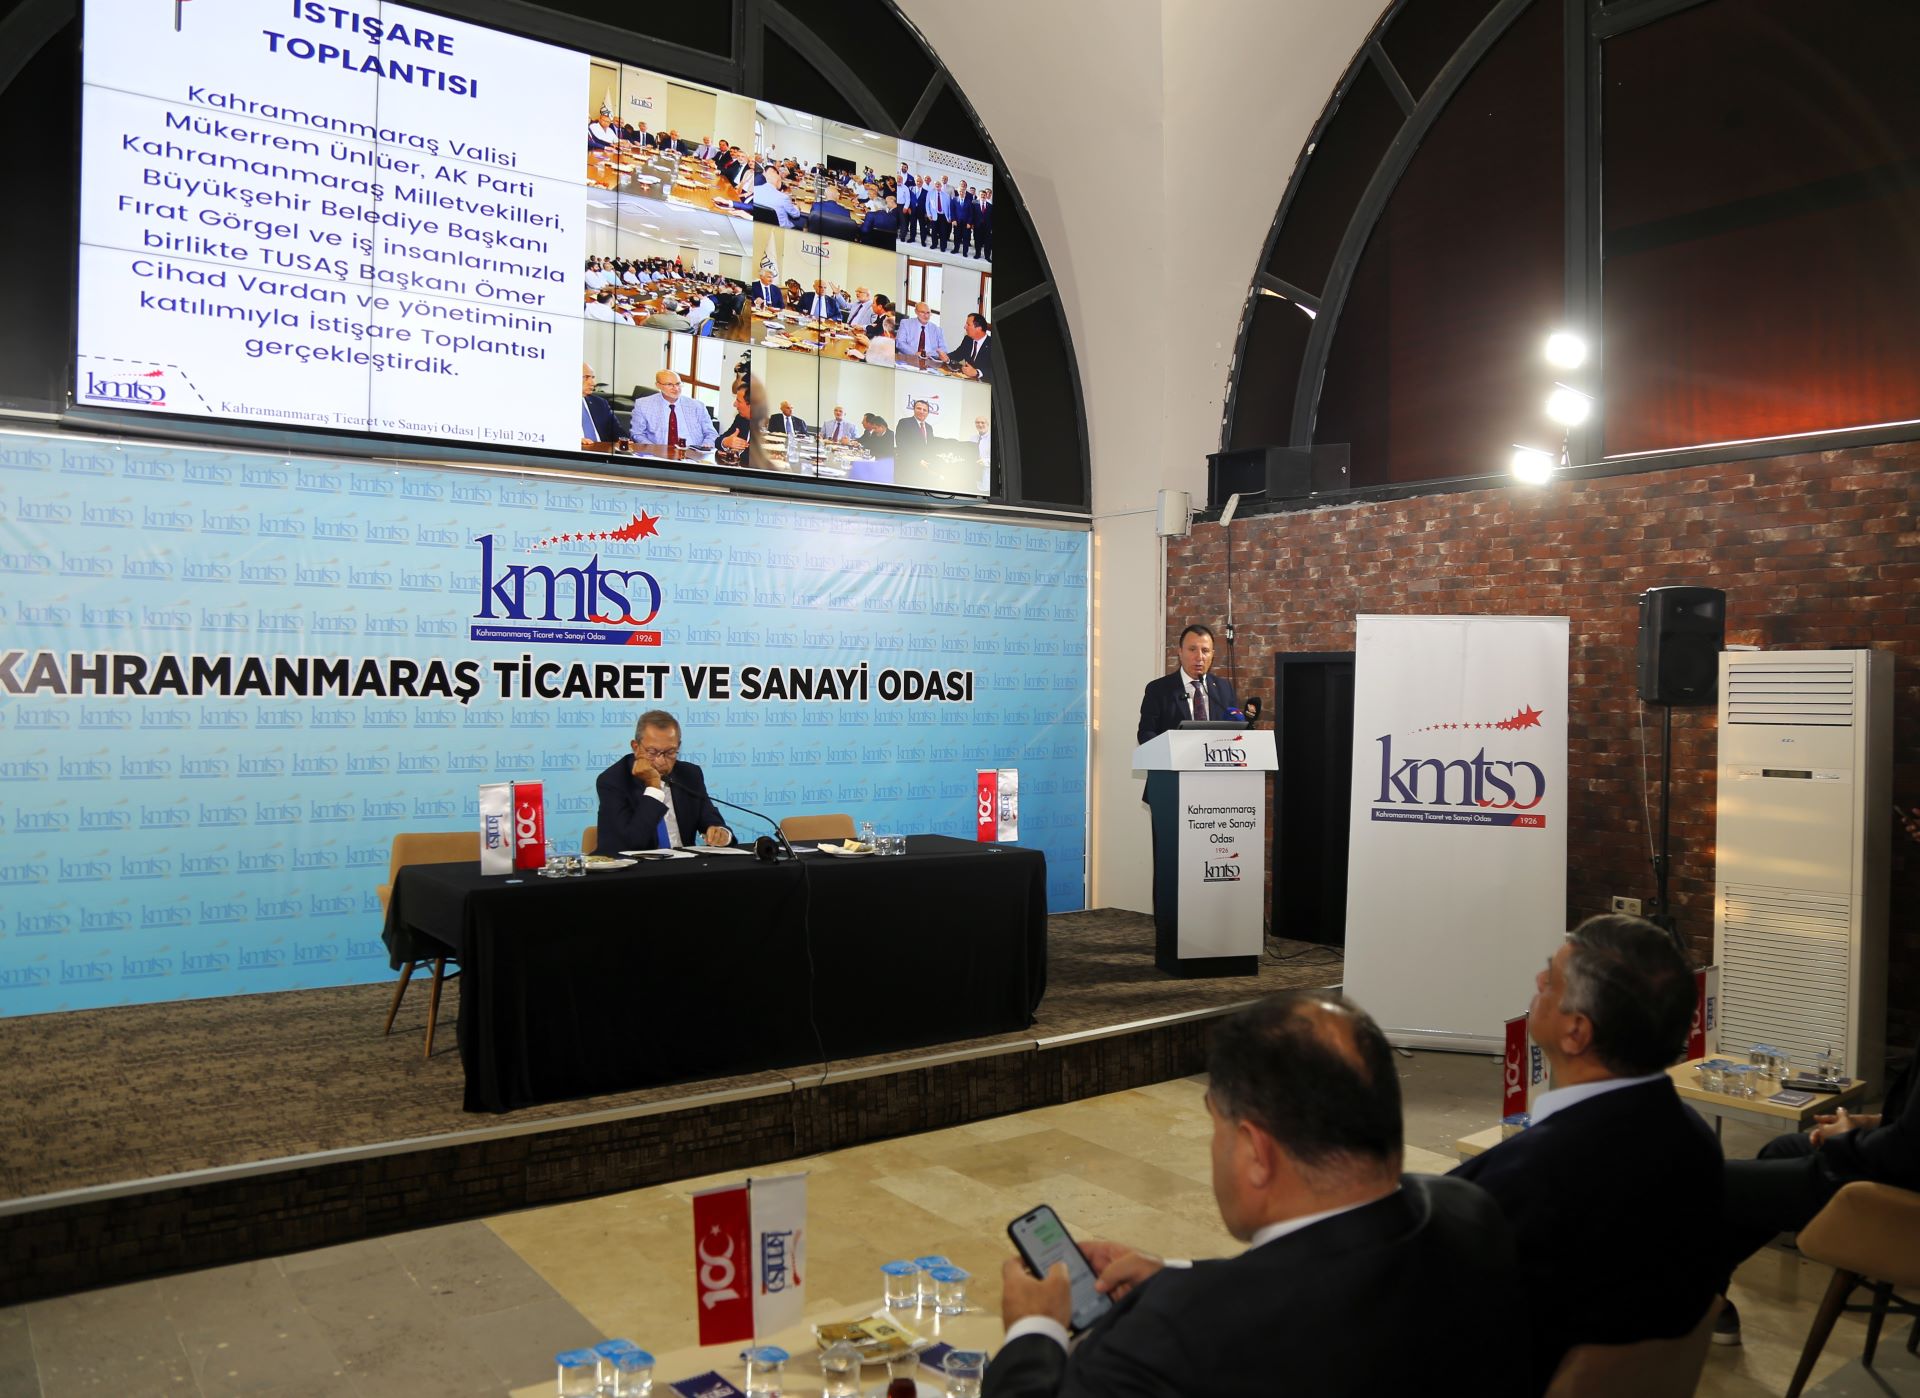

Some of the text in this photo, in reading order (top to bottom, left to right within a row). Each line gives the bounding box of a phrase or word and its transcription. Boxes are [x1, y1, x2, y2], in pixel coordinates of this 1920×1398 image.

[263, 30, 477, 99] TOPLANTISI
[165, 111, 533, 198] Mükerrem Ünlüer, AK Parti
[188, 85, 517, 167] Kahramanmaraş Valisi
[123, 134, 564, 233] Kahramanmaraş Milletvekilleri,
[143, 168, 548, 253] Büyükşehir Belediye Başkanı
[118, 195, 565, 282] Fırat Görgel ve iş insanlarımızla
[143, 229, 546, 306] birlikte TUSAŞ Başkanı Ömer
[131, 260, 552, 334] Cihad Vardan ve yönetiminin
[140, 290, 545, 360] katılımıyla İstişare Toplantısı
[245, 338, 459, 376] gerçekleştirdik.
[221, 401, 329, 424] Kahramanmaraş
[332, 412, 378, 426] Ticaret
[382, 419, 395, 428] ve
[398, 418, 438, 434] Sanayi
[441, 423, 474, 437] Odası
[484, 427, 514, 442] Eylül
[517, 431, 546, 443] 2024
[473, 533, 662, 626] kmtso
[476, 628, 531, 640] Kahramanmaraş
[533, 630, 554, 640] Ticaret
[564, 631, 586, 641] Sanayi
[635, 634, 653, 643] 1926
[0, 652, 973, 704] KAHRAMANMARAŞ TİCARET VE SANAYİ ODASI
[1373, 733, 1546, 810] kmtso
[1187, 804, 1256, 816] Kahramanmaraş
[1188, 818, 1256, 830] Ticaret ve Sanayi
[1209, 833, 1235, 843] Odası
[1375, 811, 1424, 821] Kahramanmaraş
[1424, 812, 1444, 821] Ticaret
[1453, 813, 1473, 822] Sanayi
[1520, 817, 1538, 825] 1926
